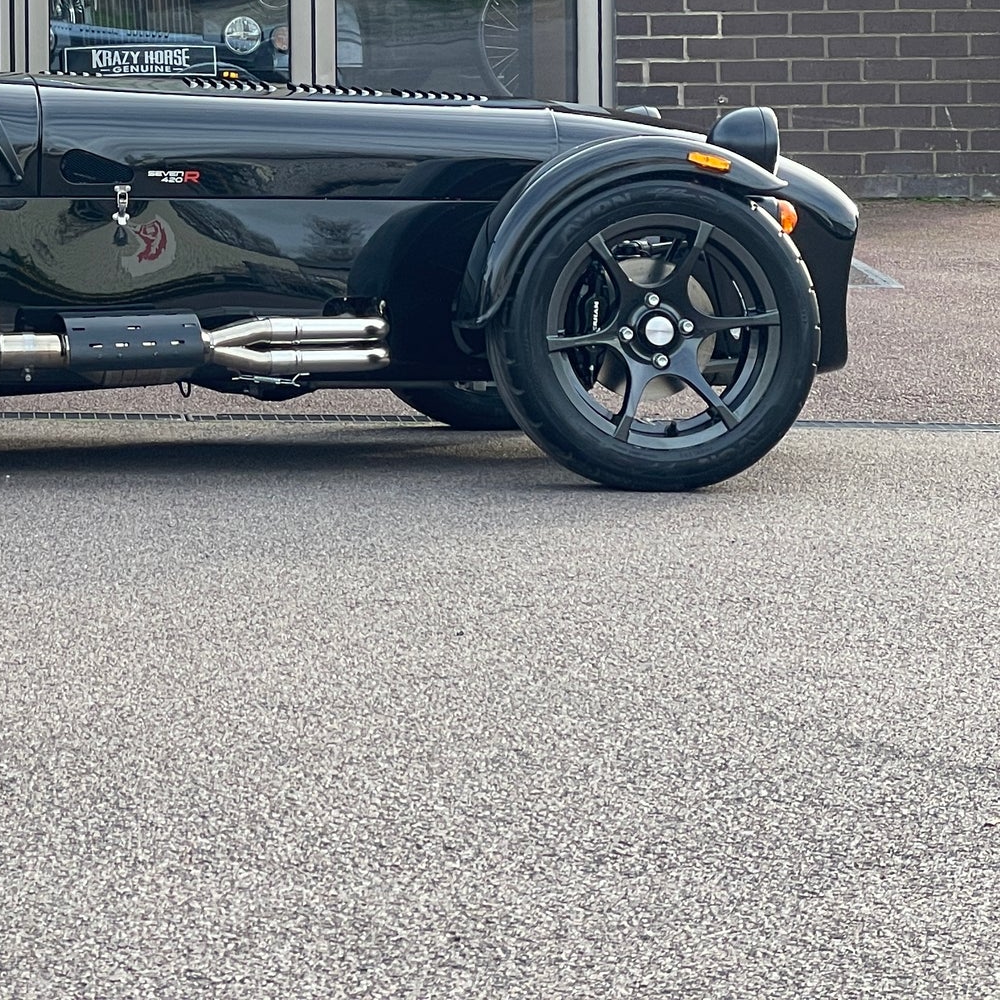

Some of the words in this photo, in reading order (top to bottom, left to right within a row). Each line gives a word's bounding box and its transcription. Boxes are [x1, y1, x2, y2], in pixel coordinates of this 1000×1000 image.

[91, 49, 141, 69] KRAZY
[144, 48, 190, 68] HORSE
[112, 64, 172, 73] GENUINE
